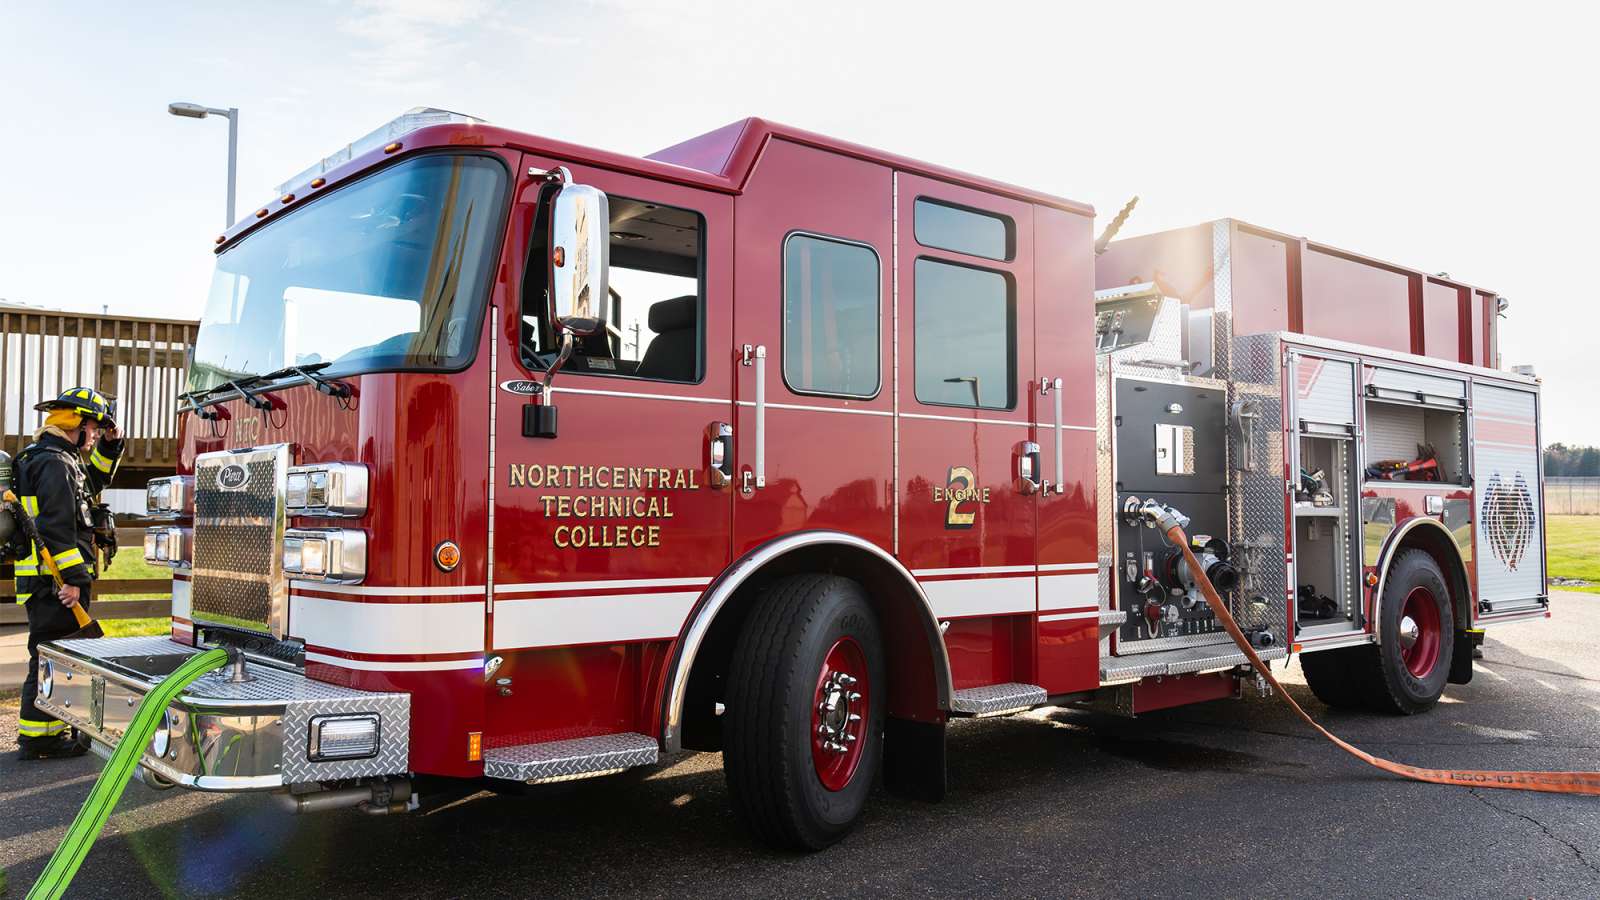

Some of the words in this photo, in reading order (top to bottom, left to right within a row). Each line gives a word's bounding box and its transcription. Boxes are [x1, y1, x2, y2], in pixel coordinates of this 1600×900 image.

[509, 463, 700, 490] NORTHCENTRAL
[933, 486, 991, 503] ENGINE
[946, 466, 976, 530] 2
[540, 495, 674, 518] TECHNICAL
[553, 525, 660, 548] COLLEGE
